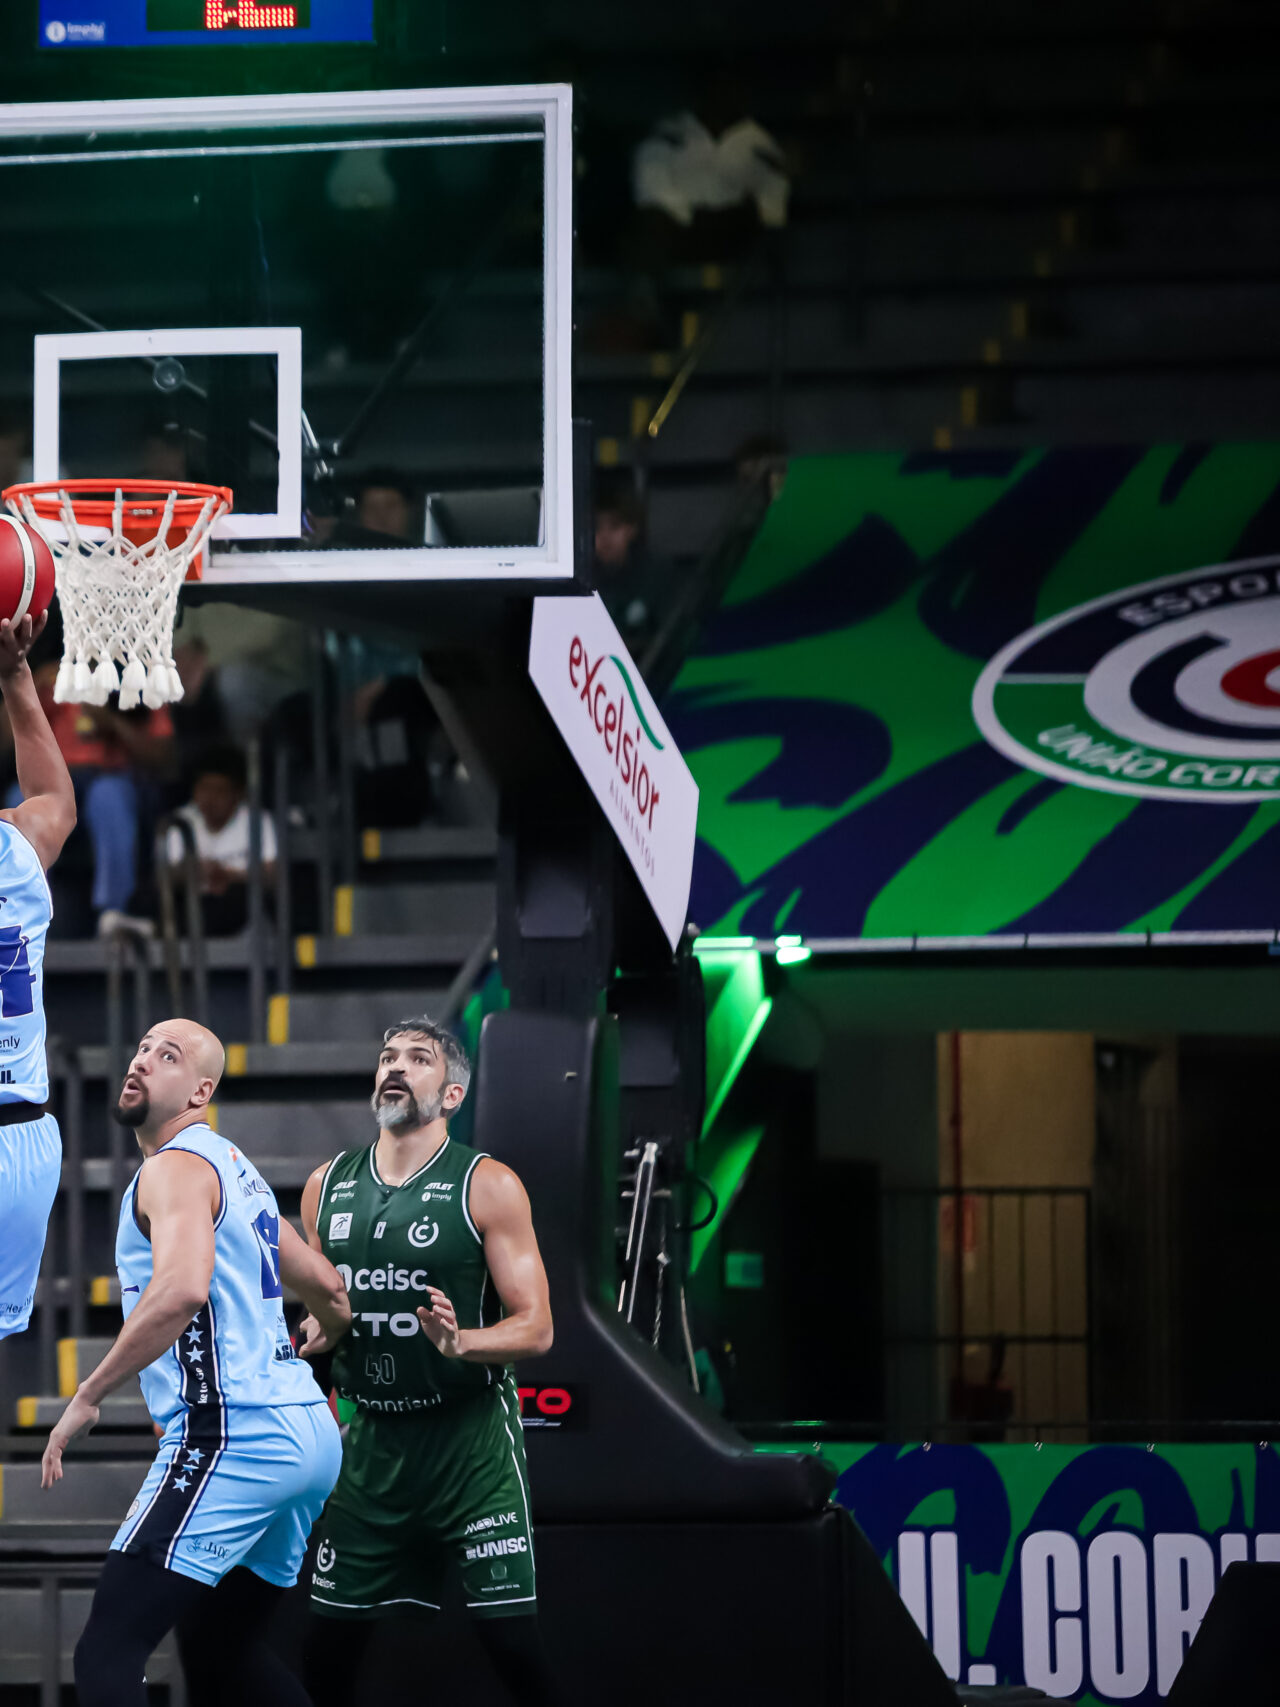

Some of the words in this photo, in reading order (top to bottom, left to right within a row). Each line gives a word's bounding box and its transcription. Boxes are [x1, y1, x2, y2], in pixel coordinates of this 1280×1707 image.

[569, 634, 660, 832] excelsior
[354, 1262, 428, 1291] ceisc
[517, 1387, 572, 1415] TO
[476, 1536, 528, 1558] UNISC
[1021, 1530, 1280, 1699] COR
